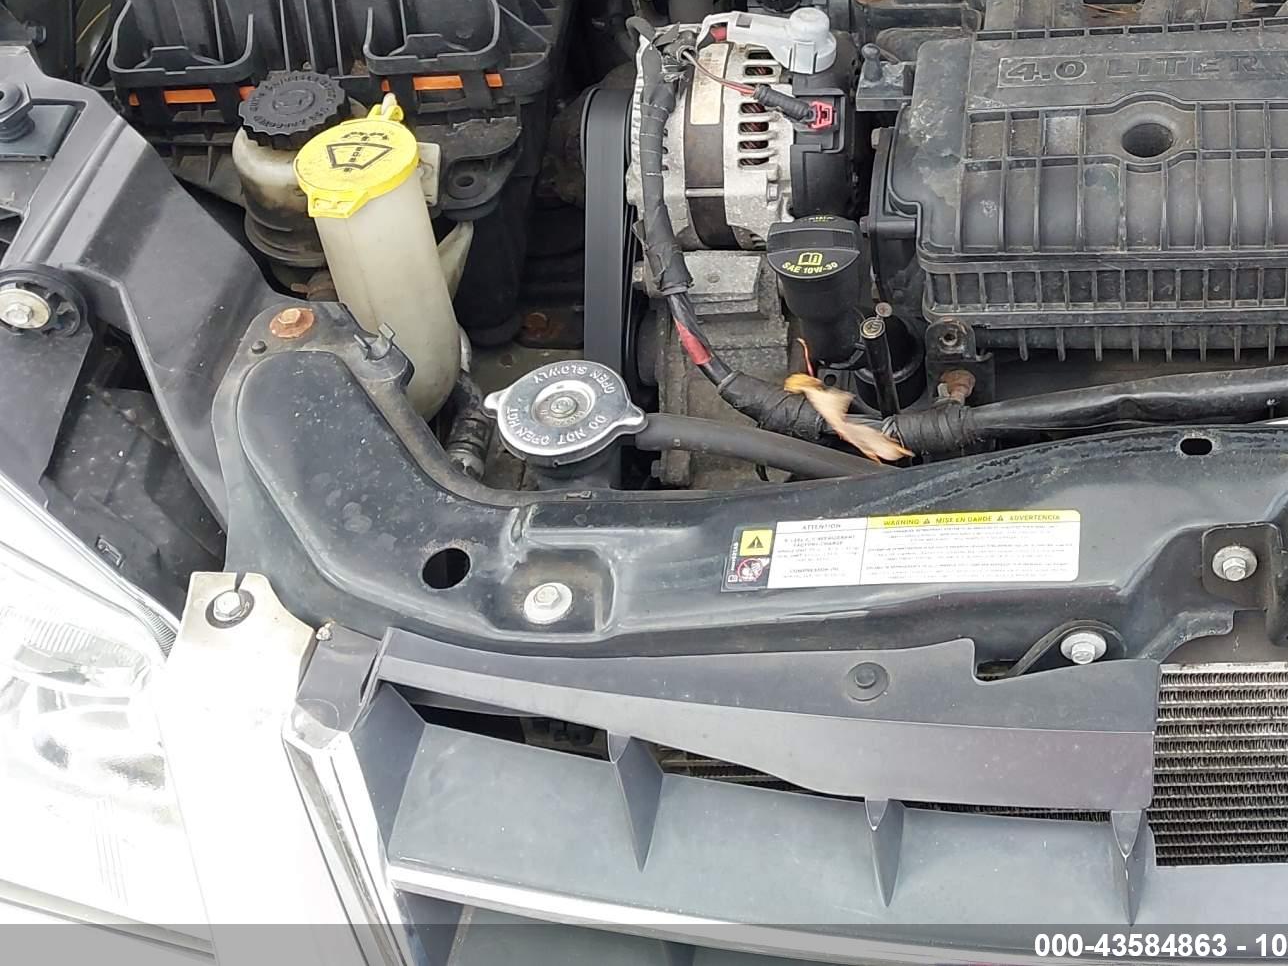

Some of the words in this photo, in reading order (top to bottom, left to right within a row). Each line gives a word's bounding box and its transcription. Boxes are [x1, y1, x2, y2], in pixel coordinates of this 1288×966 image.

[1005, 59, 1088, 84] 4.0
[1105, 54, 1260, 80] LITER
[781, 261, 801, 274] SAE
[803, 261, 839, 274] 10W-30
[532, 365, 588, 385] SLOWLY
[589, 368, 617, 395] OPEN
[588, 414, 609, 430] DO
[516, 427, 551, 446] OPEN
[556, 428, 588, 446] NOT
[883, 518, 920, 526] WARNING
[936, 516, 953, 524] MISE
